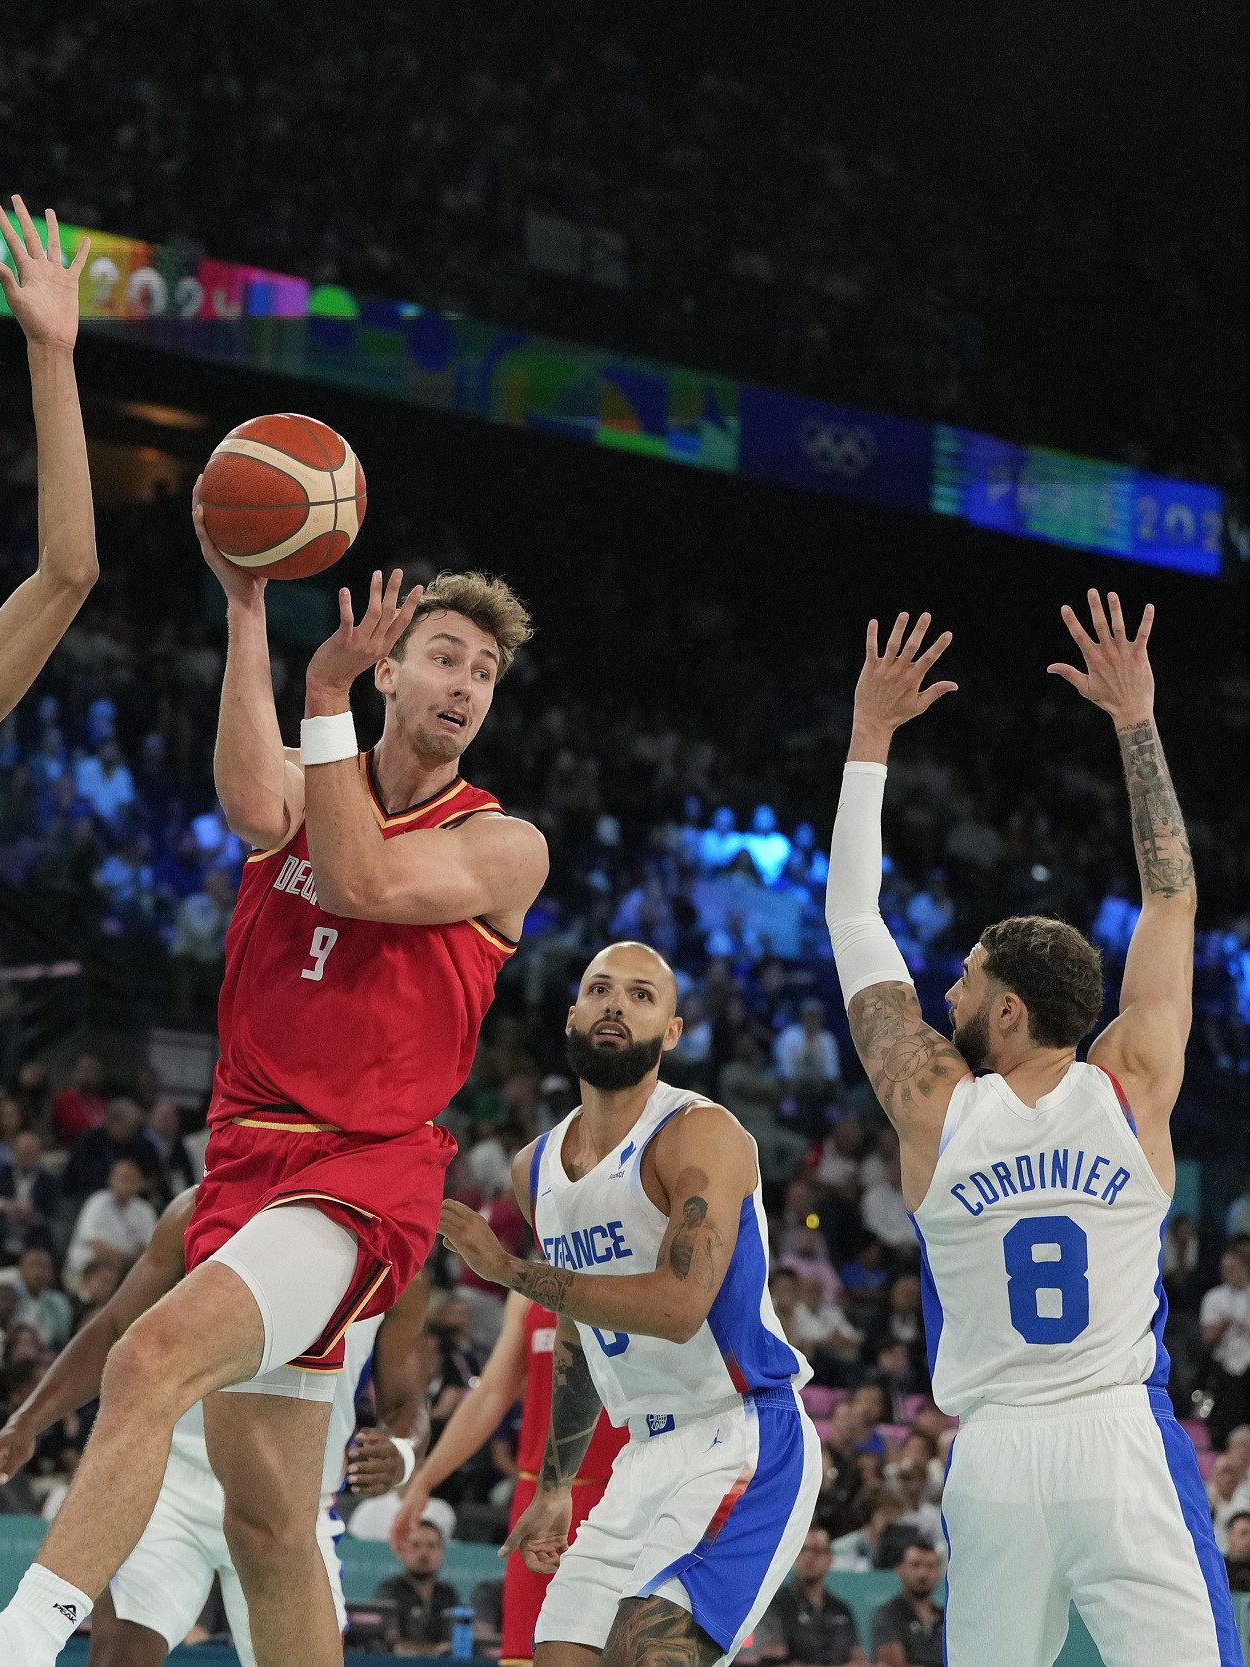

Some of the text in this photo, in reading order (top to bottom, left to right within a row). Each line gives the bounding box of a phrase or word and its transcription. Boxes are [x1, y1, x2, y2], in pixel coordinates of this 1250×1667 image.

[301, 926, 339, 981] 9
[950, 1148, 1131, 1217] CORDINIER
[1002, 1215, 1090, 1345] 8
[52, 1602, 77, 1625] PEAK
